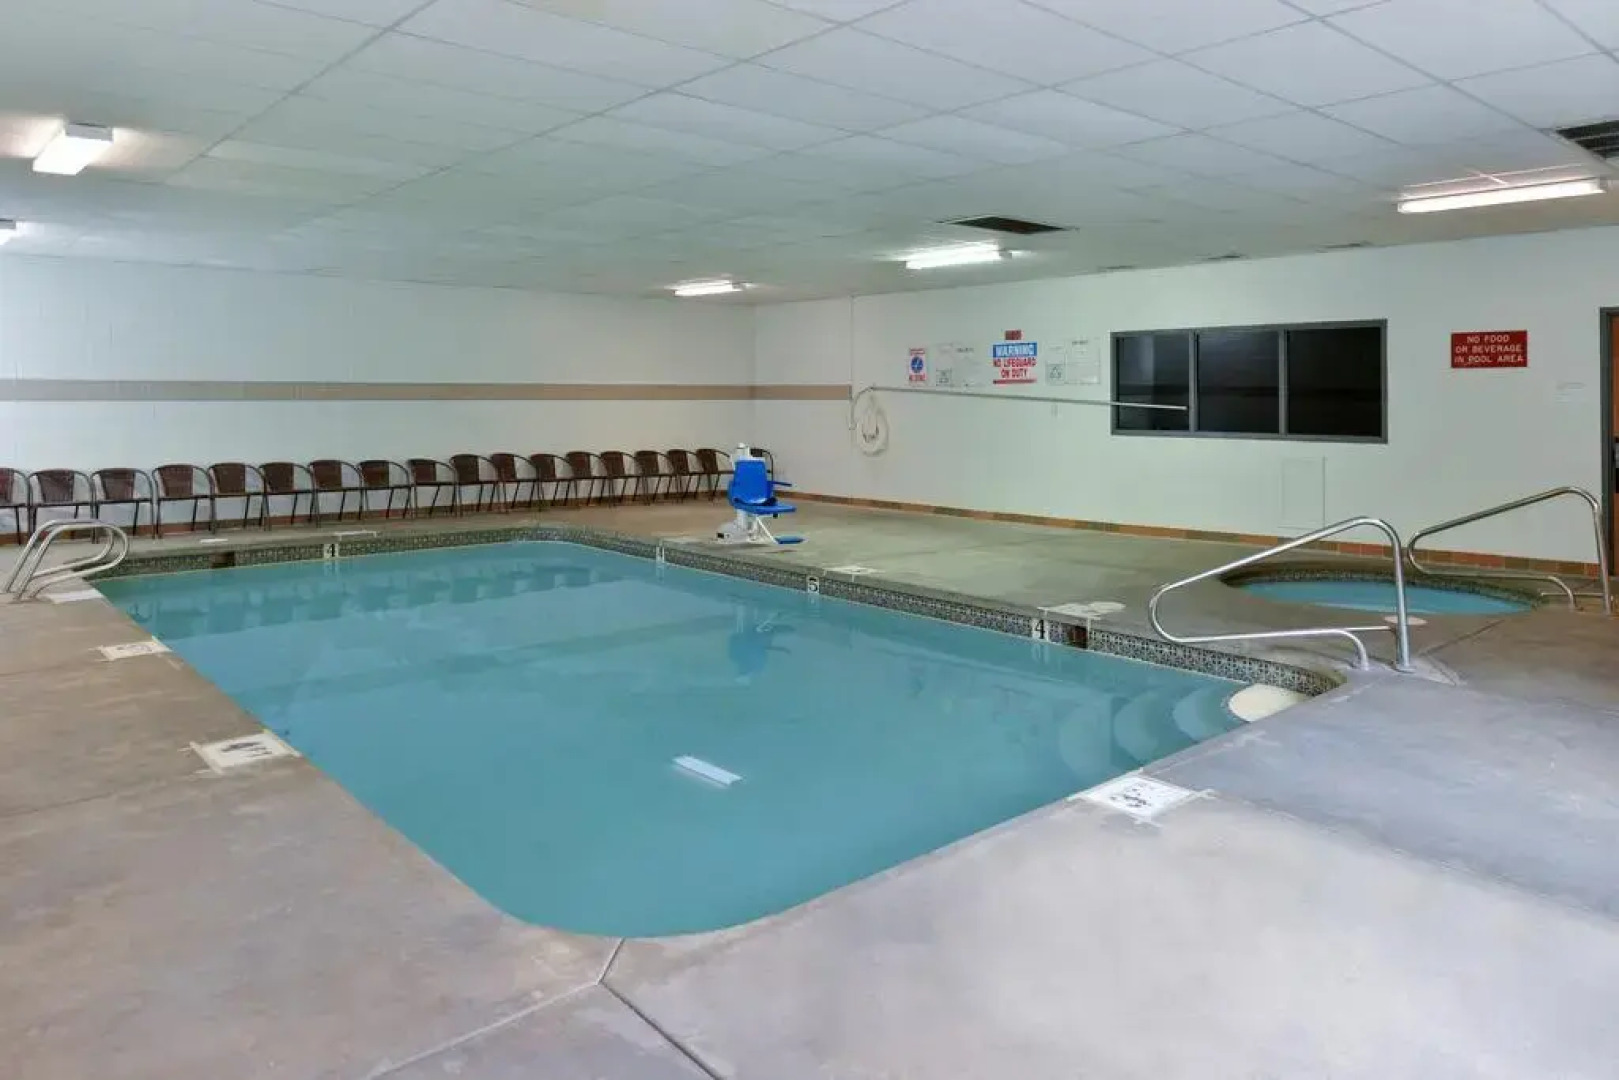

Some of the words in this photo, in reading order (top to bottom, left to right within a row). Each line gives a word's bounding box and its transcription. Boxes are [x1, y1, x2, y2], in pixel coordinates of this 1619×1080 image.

[1466, 336, 1480, 344] NO
[1484, 334, 1510, 343] FOOD
[995, 345, 1035, 356] WARNING
[1455, 345, 1468, 353] OR
[1471, 344, 1522, 353] BEVERAGE
[993, 358, 1002, 367] NO
[1003, 357, 1036, 367] LIFEGUARD
[1468, 355, 1493, 363] POOL
[1496, 354, 1524, 362] AREA
[1001, 369, 1010, 378] ON
[1011, 368, 1028, 378] DUTY
[808, 577, 818, 592] 5
[1035, 619, 1046, 640] 4
